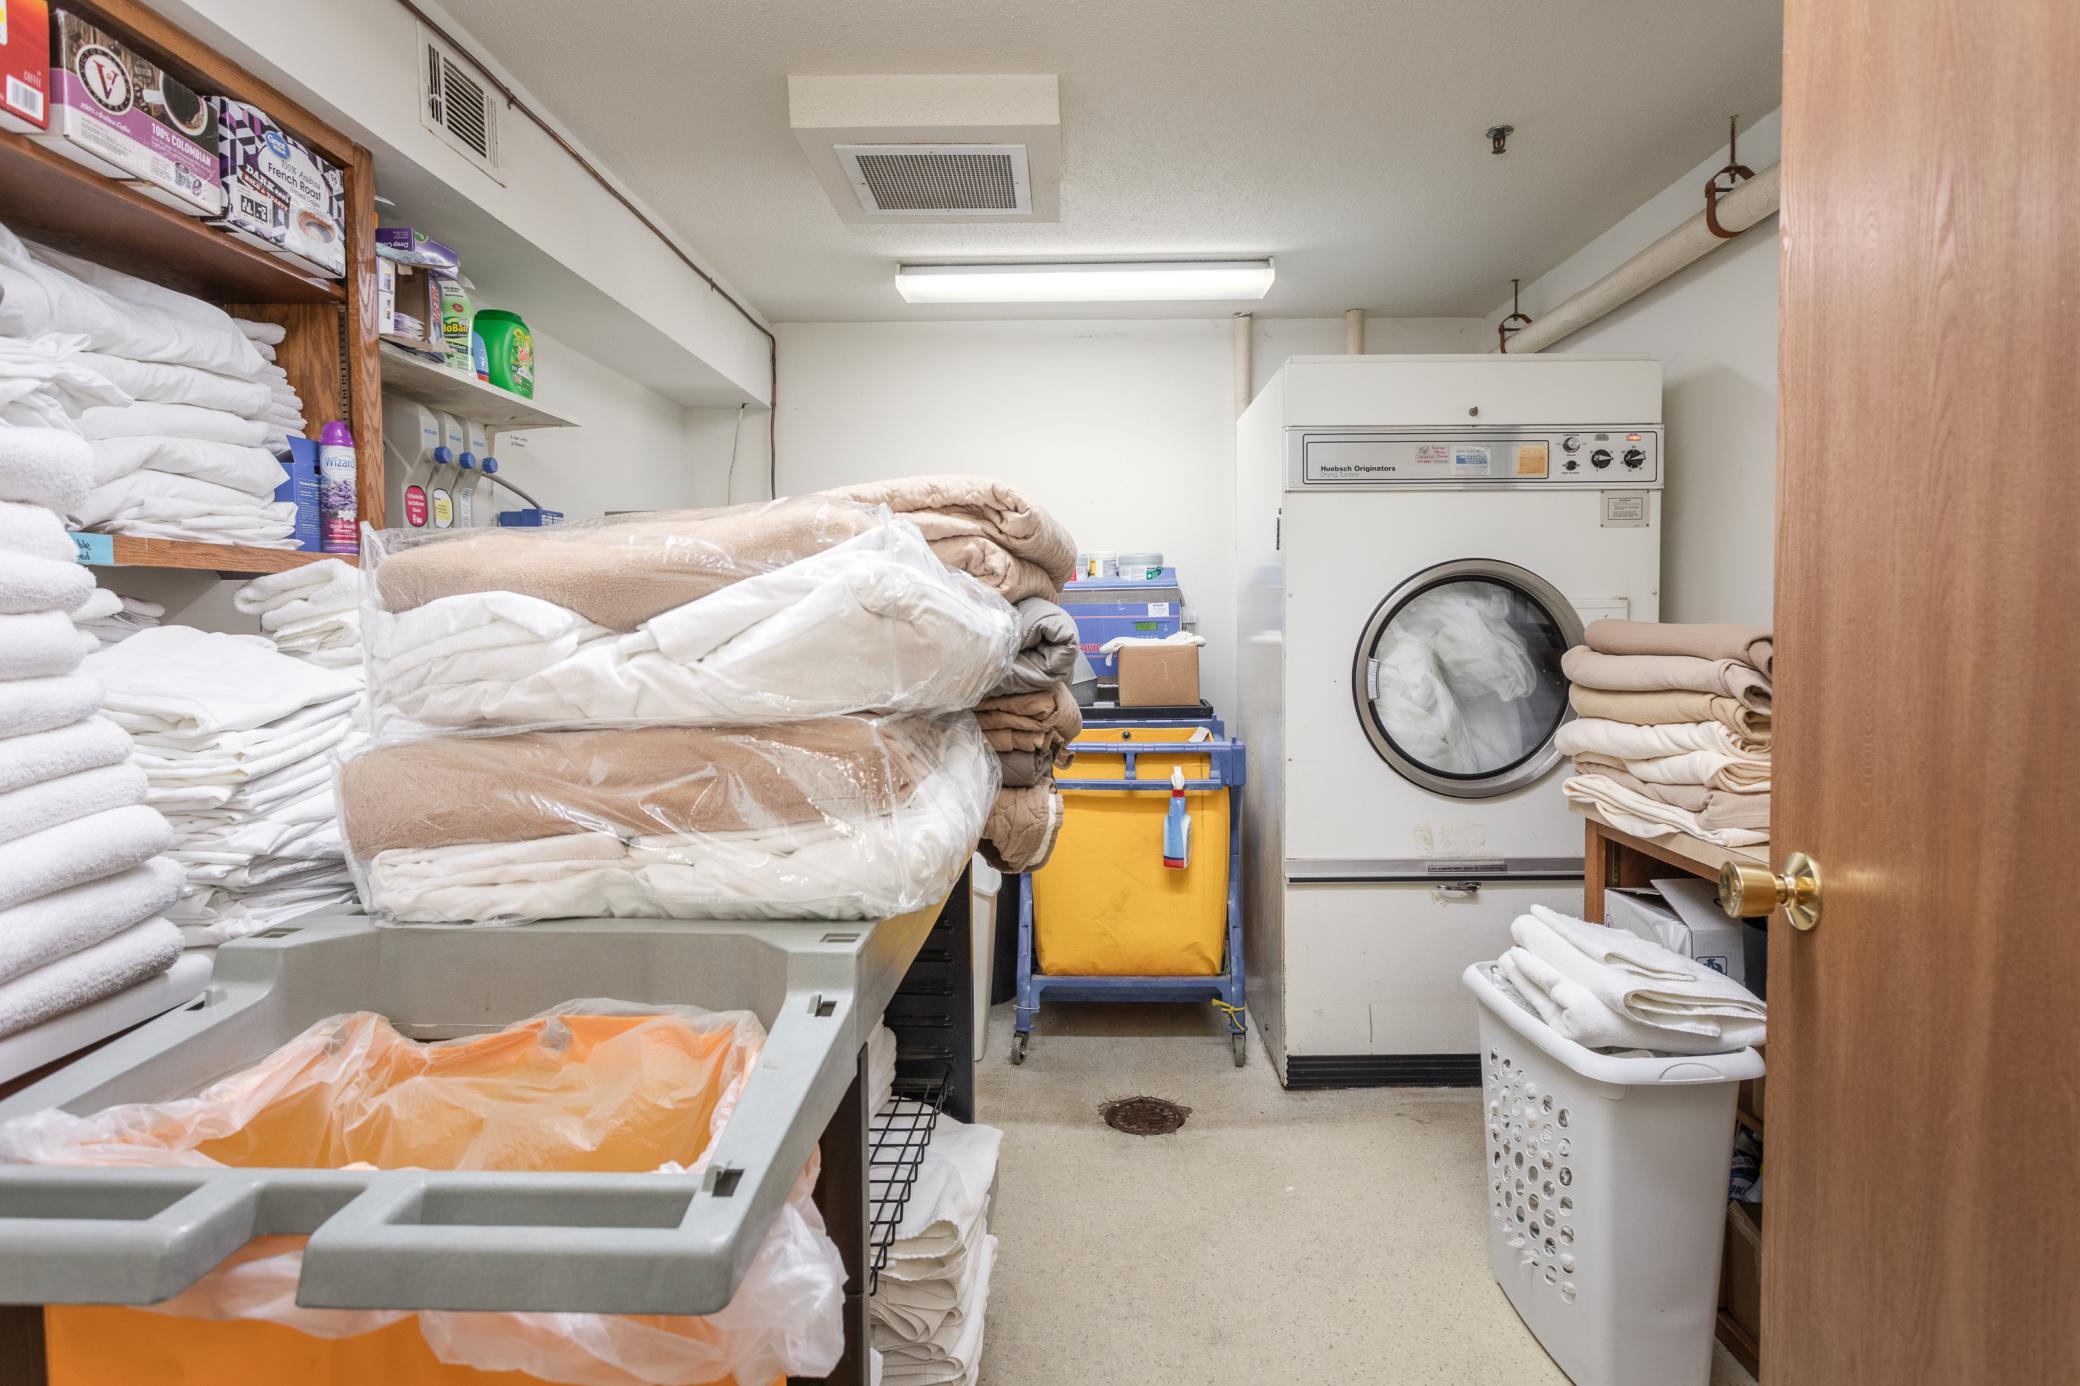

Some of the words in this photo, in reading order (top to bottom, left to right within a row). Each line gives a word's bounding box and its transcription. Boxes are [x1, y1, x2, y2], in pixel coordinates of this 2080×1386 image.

[152, 122, 171, 143] 100%
[171, 134, 212, 168] COLOMBIAN
[268, 161, 299, 188] French
[299, 181, 321, 202] Roast
[281, 160, 297, 176] 100%
[1354, 465, 1396, 473] Originators
